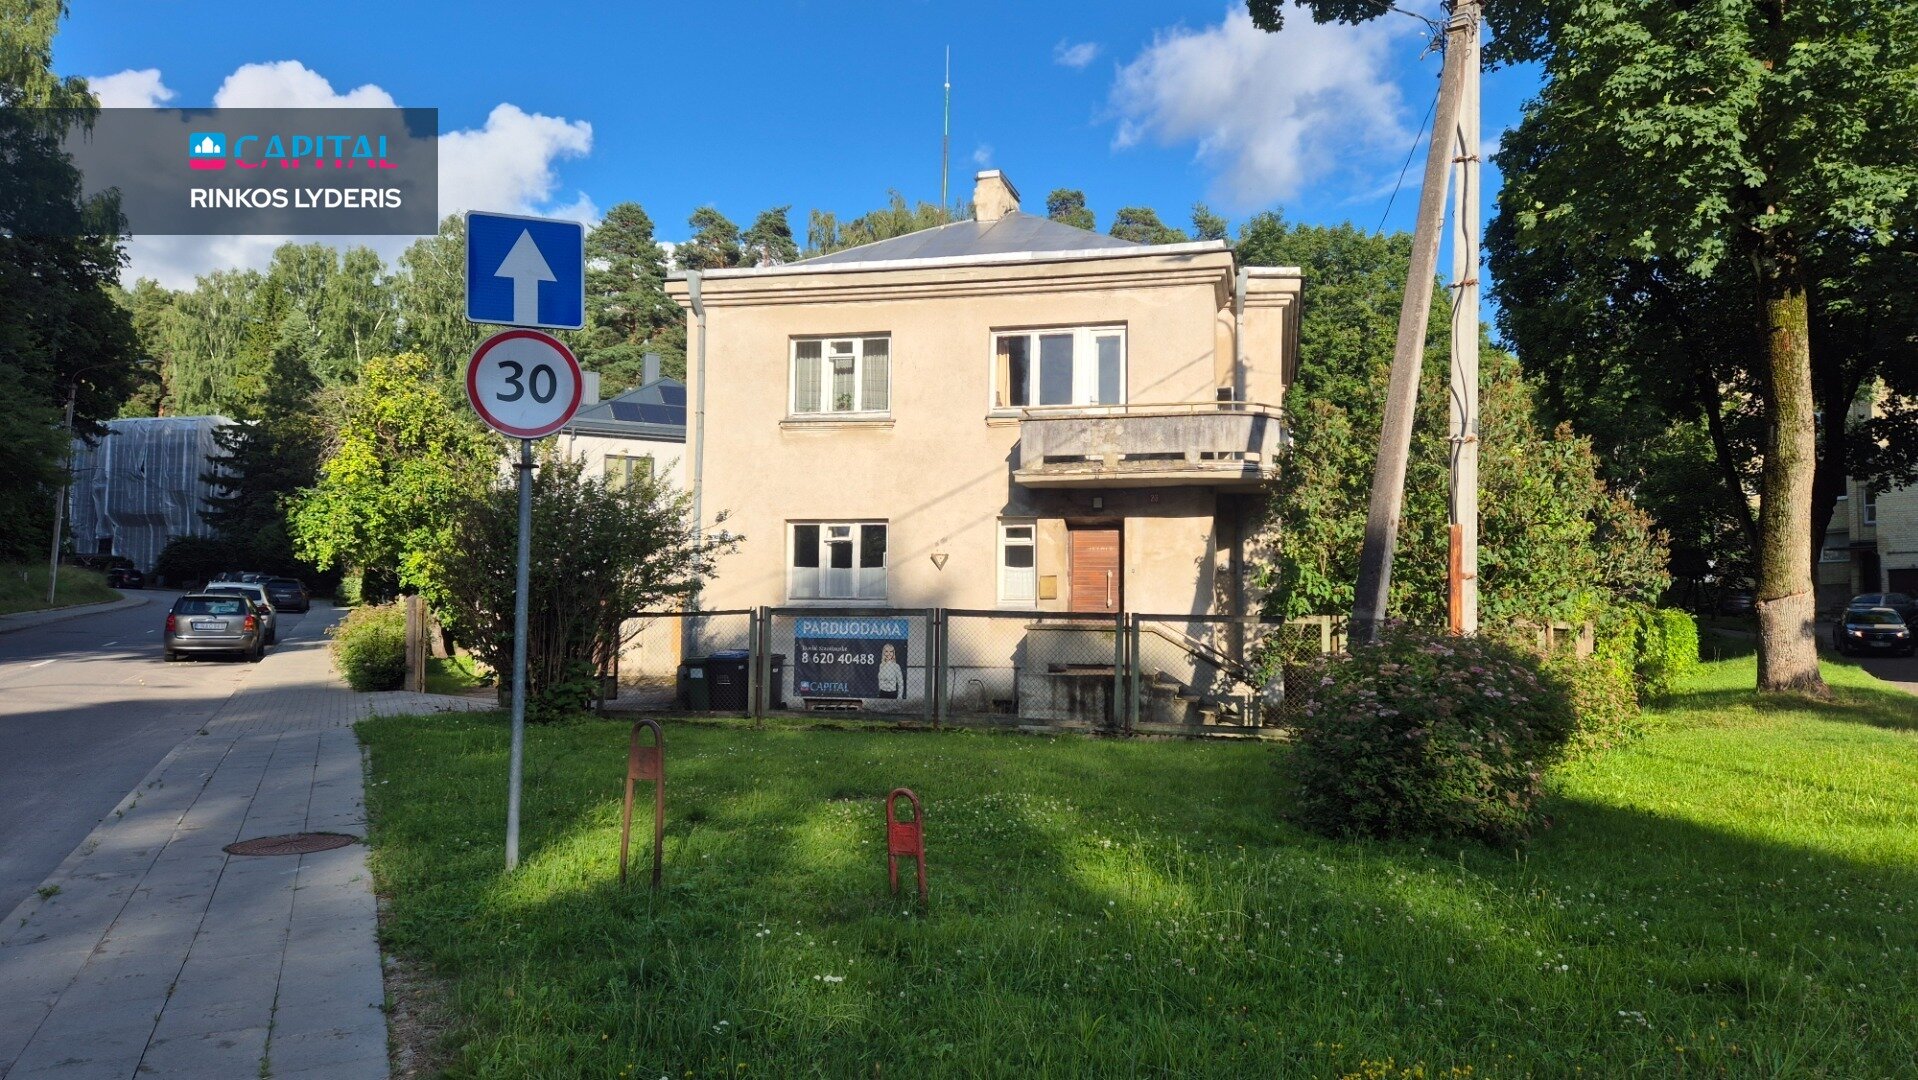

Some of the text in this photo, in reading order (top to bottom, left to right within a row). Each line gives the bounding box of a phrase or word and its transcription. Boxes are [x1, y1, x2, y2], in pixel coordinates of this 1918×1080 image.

[496, 360, 557, 404] 30
[803, 621, 901, 636] PARDUODAMA
[801, 652, 874, 664] 8 620 40488
[809, 681, 849, 692] CAPITAL
